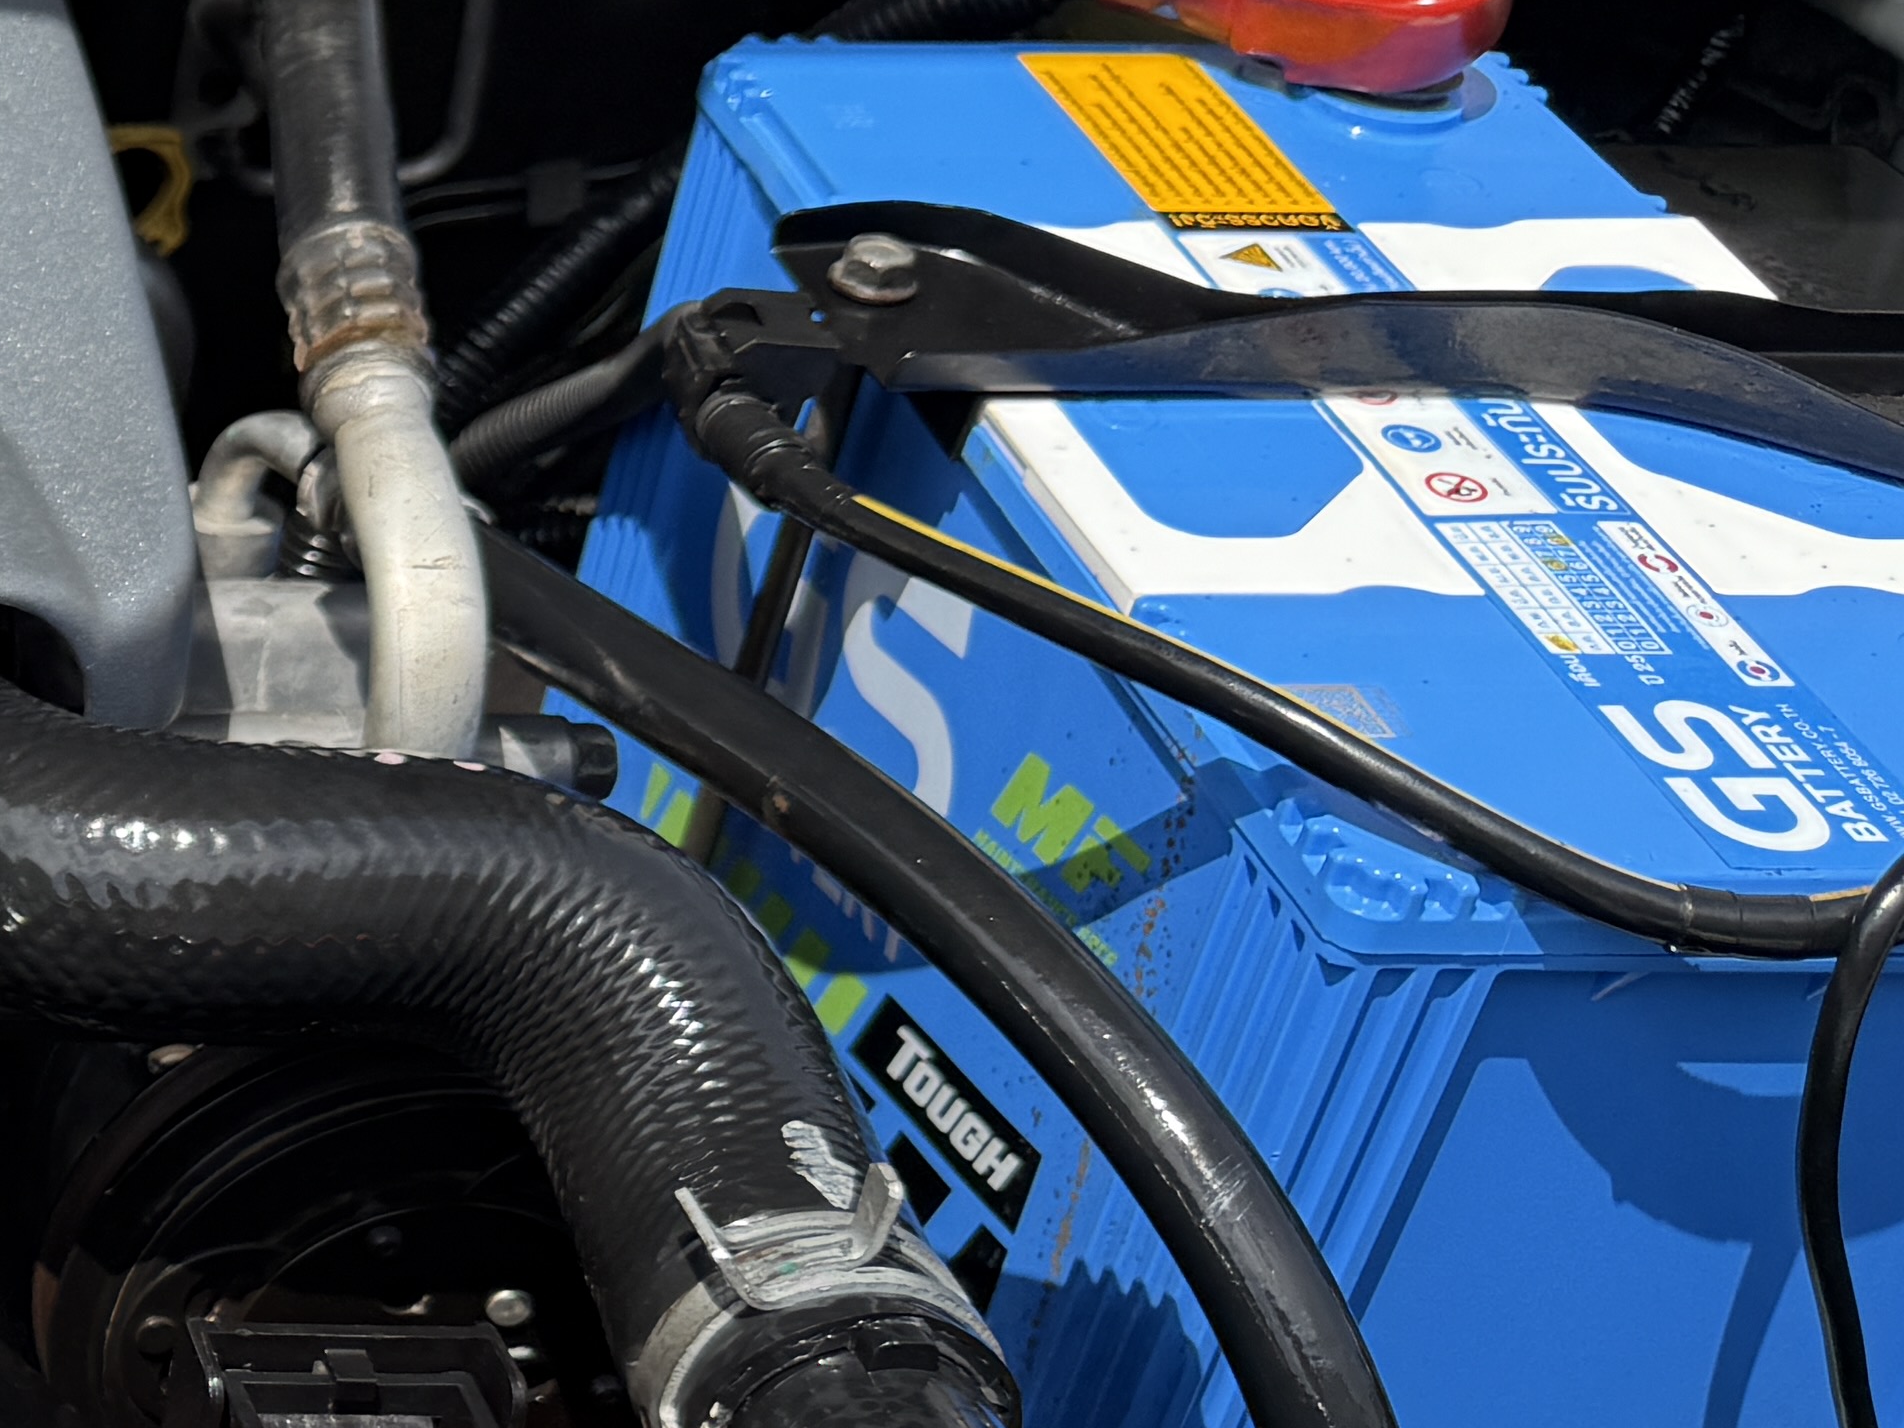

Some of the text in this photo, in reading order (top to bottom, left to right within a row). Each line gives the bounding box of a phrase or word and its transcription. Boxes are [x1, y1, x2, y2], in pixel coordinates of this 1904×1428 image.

[990, 752, 1152, 894] MF
[1597, 699, 1831, 852] GS
[1728, 704, 1890, 843] BATTERY
[885, 1024, 1026, 1192] TOUGH
